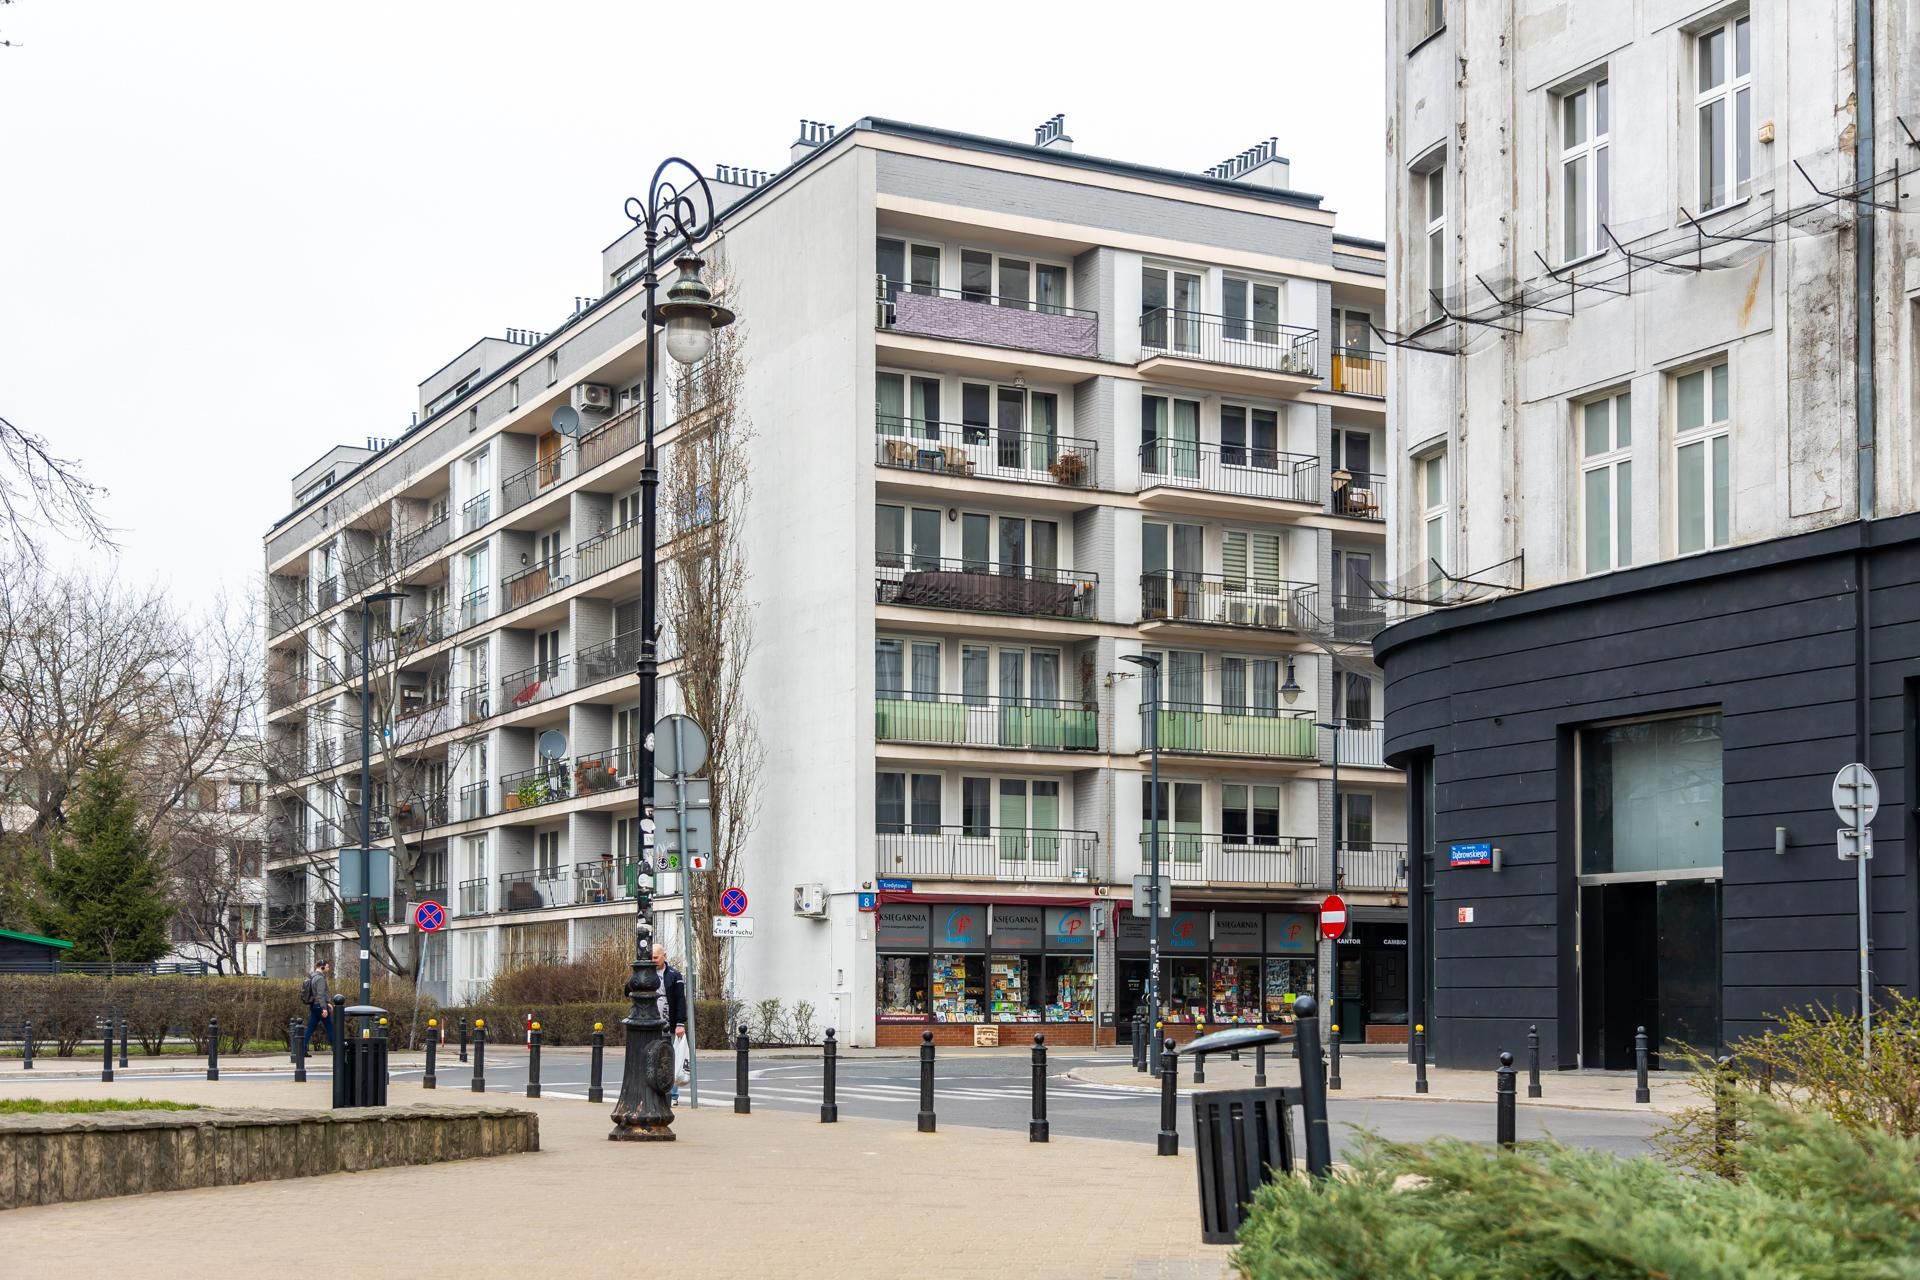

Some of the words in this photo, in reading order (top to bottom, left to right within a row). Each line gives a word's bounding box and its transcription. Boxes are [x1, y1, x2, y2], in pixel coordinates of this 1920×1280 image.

[1452, 849, 1488, 861] Dąbrowskiego
[883, 881, 908, 890] Kredytowa
[864, 897, 870, 907] 8
[880, 913, 927, 922] KSIĘGARNIA
[993, 915, 1039, 924] KSIĘGARNIA
[1216, 921, 1258, 929] KSIĘGARNIA
